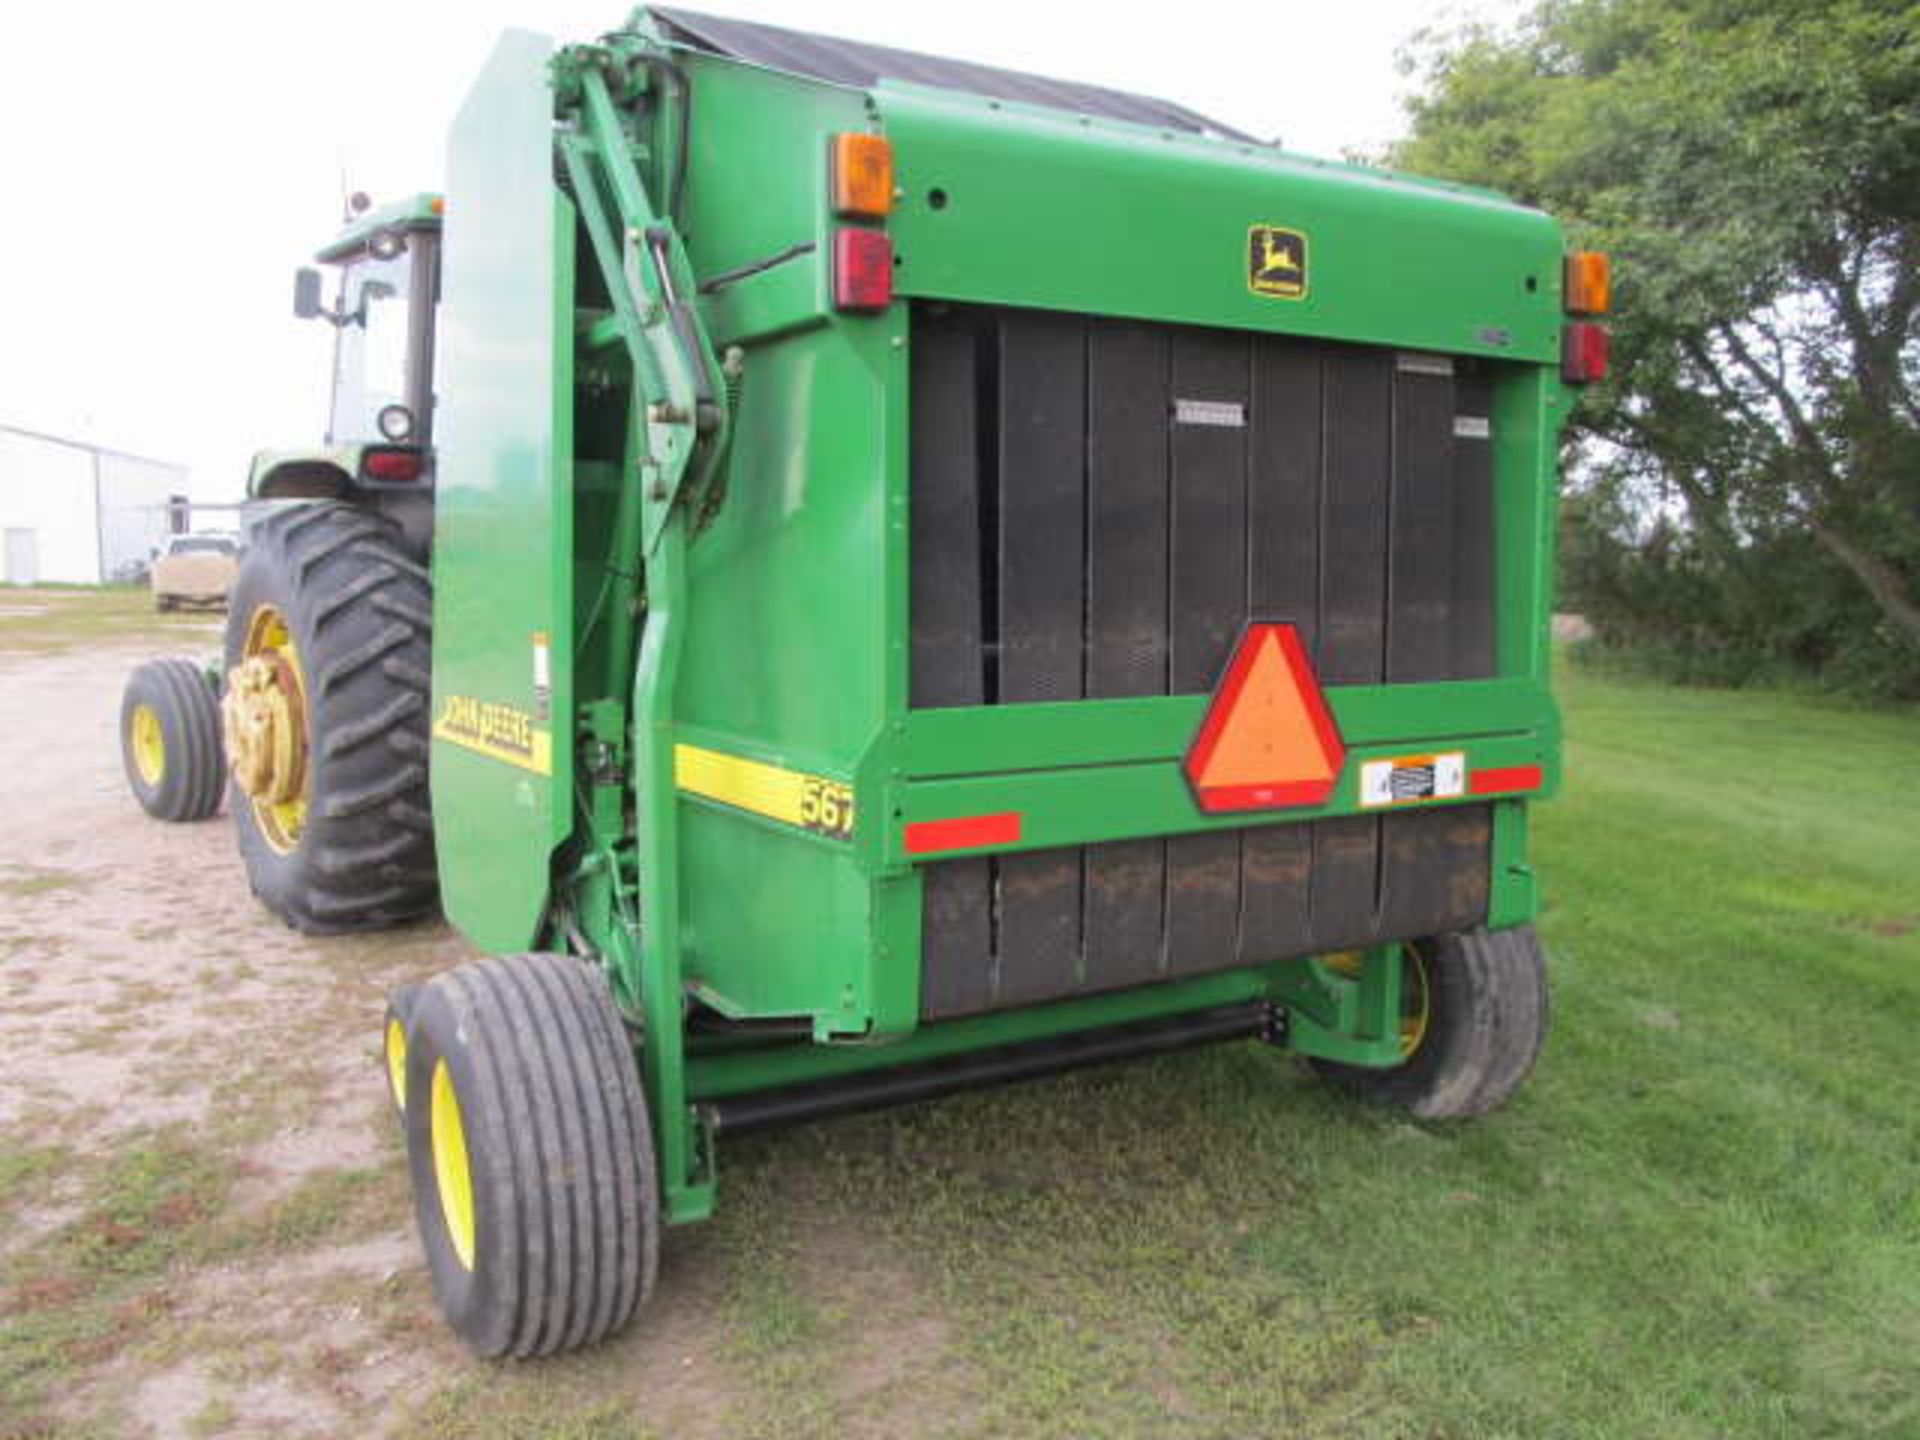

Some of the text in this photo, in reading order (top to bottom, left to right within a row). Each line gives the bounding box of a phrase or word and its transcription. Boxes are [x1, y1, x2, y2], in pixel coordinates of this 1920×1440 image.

[442, 695, 480, 735] JOHN
[481, 702, 531, 752] DEERE
[801, 780, 854, 835] 567
